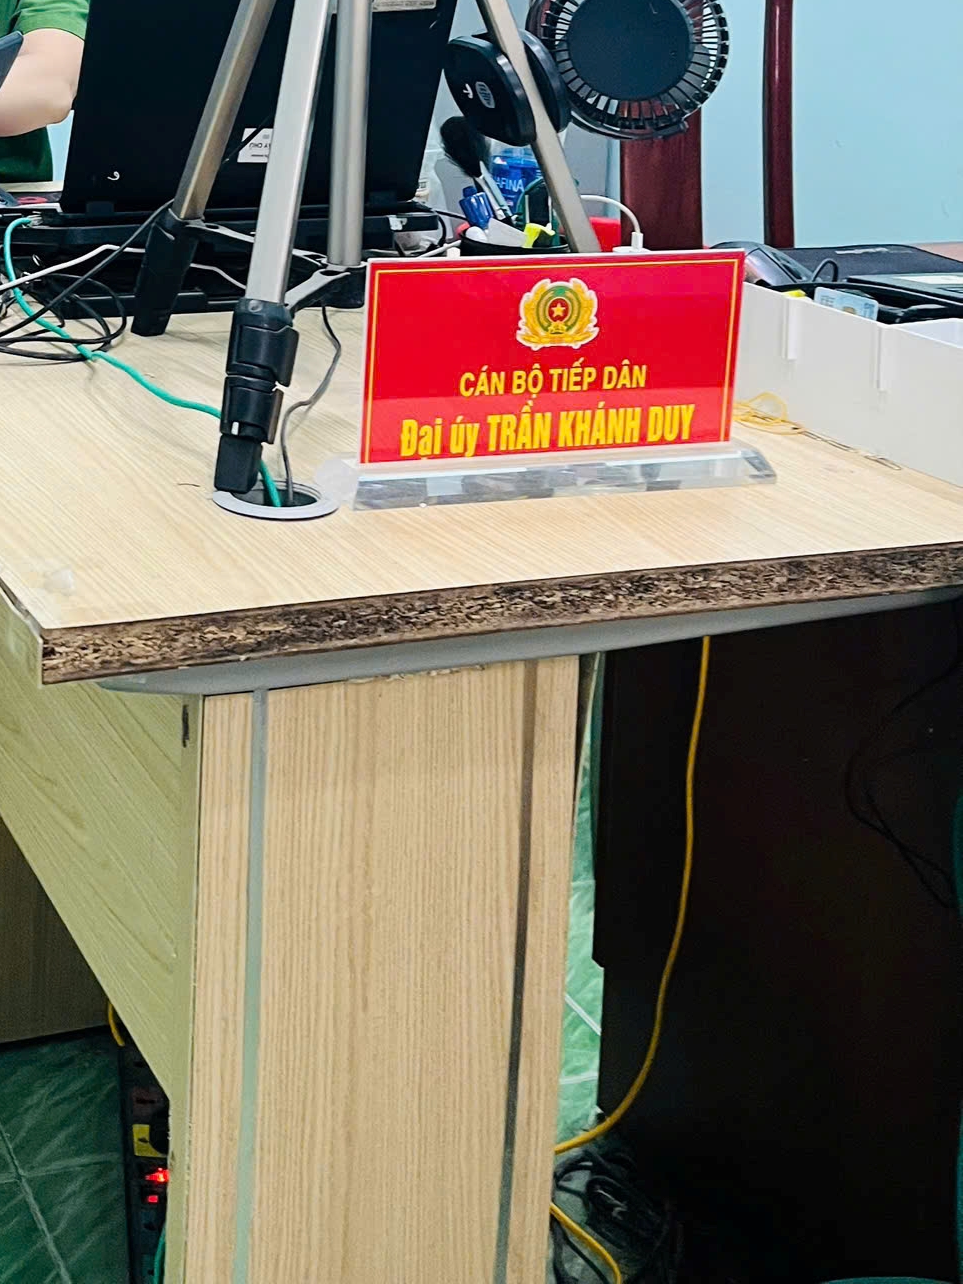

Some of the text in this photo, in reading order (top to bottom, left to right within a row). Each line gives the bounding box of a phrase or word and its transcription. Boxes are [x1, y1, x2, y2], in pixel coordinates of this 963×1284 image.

[496, 177, 525, 192] AFINA
[459, 357, 647, 399] CÁN BỘ TIẾP DÂN
[399, 400, 696, 460] Đại úy TRẦN KHÁNH DUY
